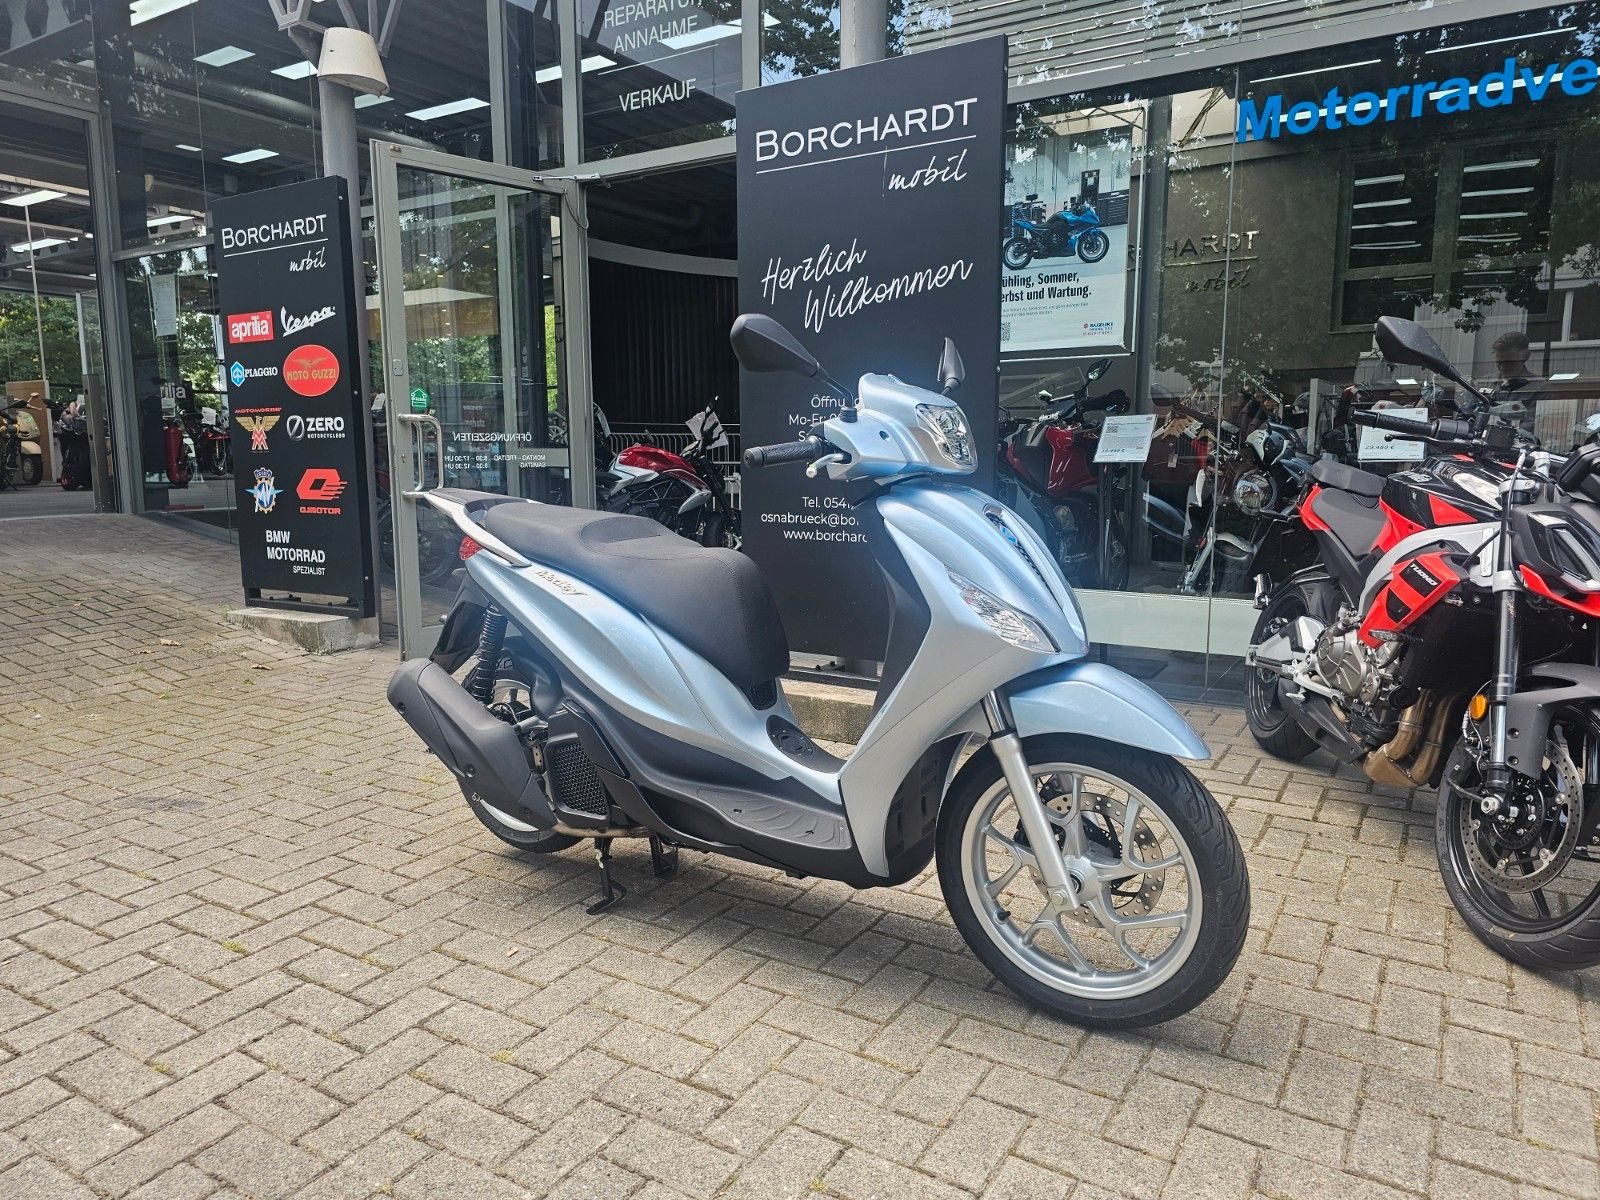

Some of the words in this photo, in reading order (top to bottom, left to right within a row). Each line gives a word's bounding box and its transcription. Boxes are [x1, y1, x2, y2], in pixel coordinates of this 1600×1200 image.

[604, 0, 700, 29] REPARATU
[613, 14, 698, 55] ANNAHME
[618, 77, 697, 112] VERKAUF
[1236, 56, 1600, 144] Motorradve
[755, 97, 978, 162] BORCHARDT
[887, 149, 969, 191] mobil
[221, 214, 327, 249] BORCHARDT
[289, 246, 327, 272] mobil
[760, 238, 867, 305] Herzlich
[1001, 274, 1035, 289] ühling,
[1037, 271, 1080, 285] Sommer,
[804, 258, 974, 333] Willkommen
[1000, 289, 1024, 303] erbst
[1026, 287, 1045, 301] und
[1047, 284, 1092, 300] Wartung.
[231, 317, 270, 341] aprilia
[280, 306, 336, 338] Vespa
[244, 366, 279, 378] PIAGGIO
[287, 370, 309, 380] MOTO
[311, 368, 337, 379] GUZZI
[810, 394, 860, 409] Öffnu
[306, 416, 345, 432] ZERO
[801, 496, 821, 508] Tel.
[760, 511, 859, 528] osnabrueck@bo
[265, 530, 291, 544] BMW
[266, 546, 326, 563] MOTORRAD
[292, 565, 326, 576] SPEZIALIST
